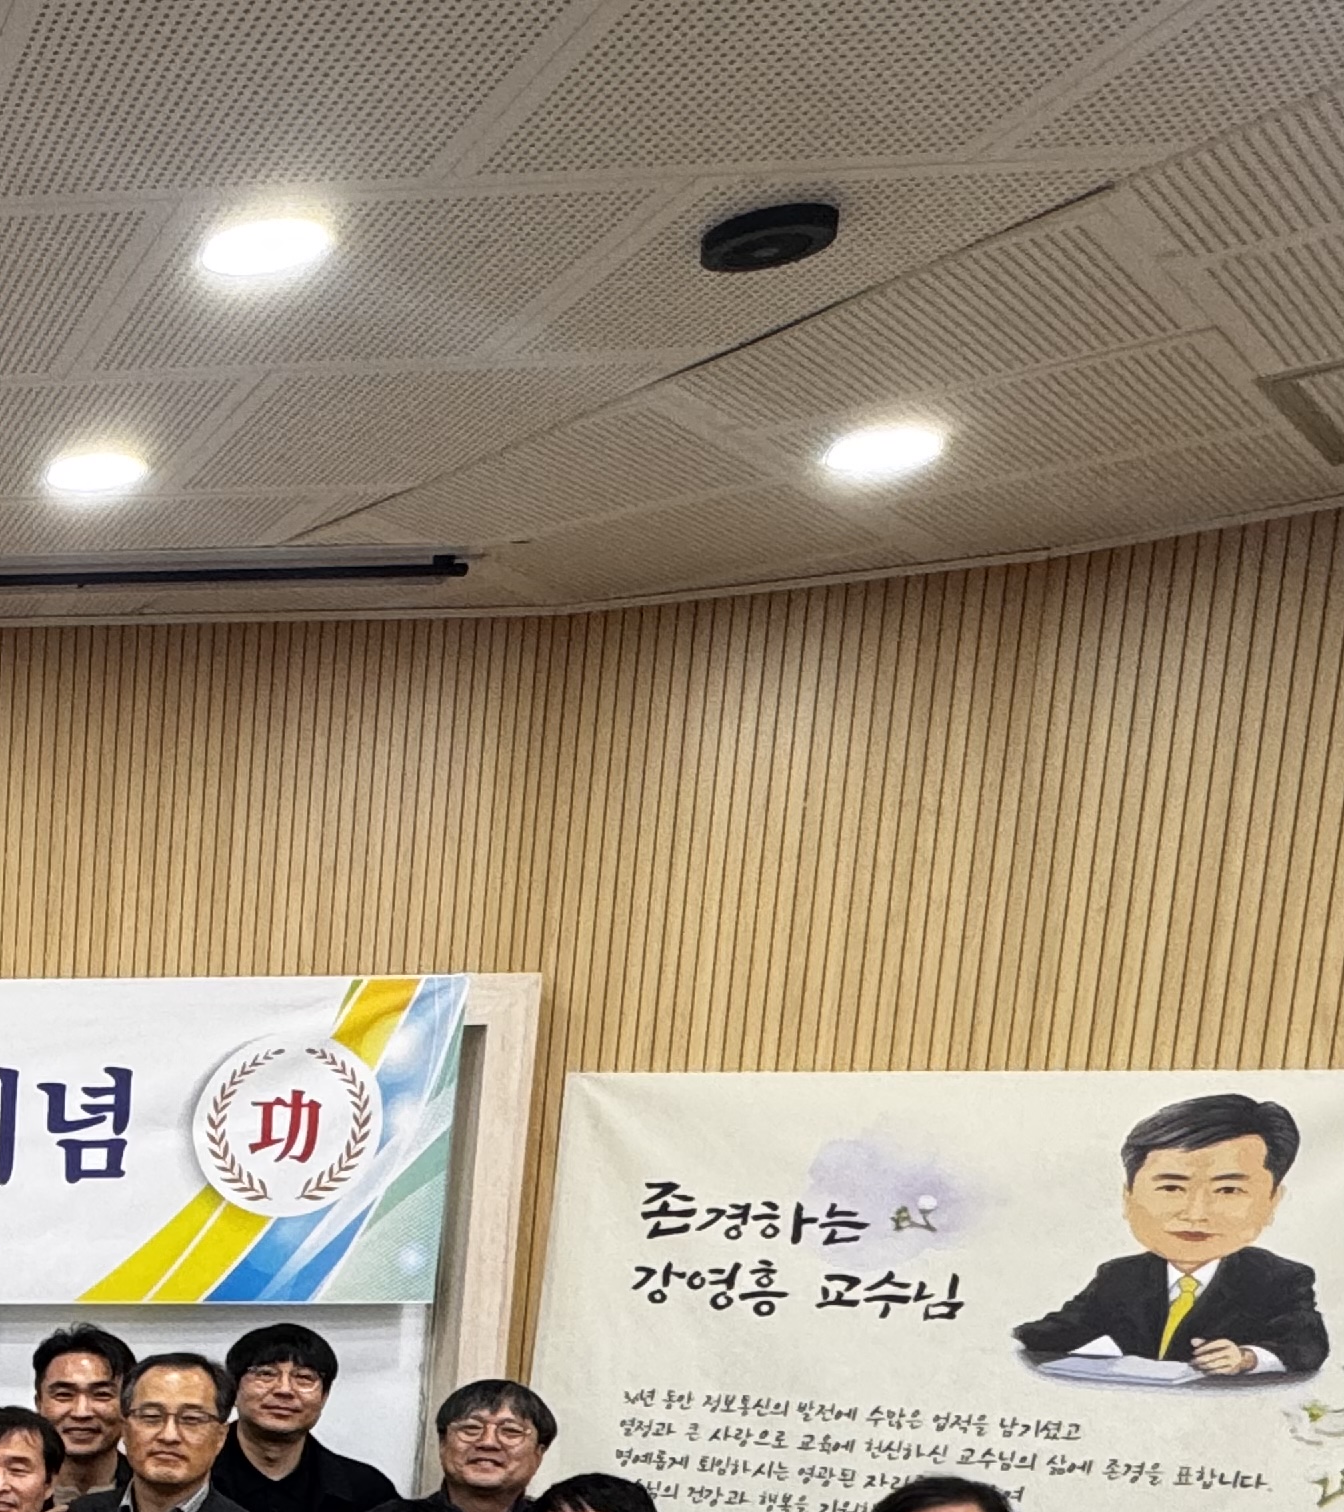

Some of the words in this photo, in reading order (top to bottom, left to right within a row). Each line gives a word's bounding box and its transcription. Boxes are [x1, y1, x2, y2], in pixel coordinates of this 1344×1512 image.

[249, 1089, 322, 1163] 功
[640, 1181, 871, 1246] 존경하는
[631, 1259, 789, 1317] 강영흥
[815, 1271, 965, 1321] 교수님
[662, 1390, 694, 1410] 동안
[702, 1394, 789, 1417] 정보통신의
[796, 1400, 858, 1422] 발전에
[866, 1406, 922, 1430] 수많은
[933, 1412, 988, 1437] 업적을
[999, 1417, 1081, 1441] 남기셨고
[616, 1448, 689, 1471] 명예롭게
[697, 1456, 789, 1481] 퇴임하시는
[798, 1465, 856, 1488] 영광된
[620, 1417, 676, 1438] 열정과
[685, 1423, 699, 1441] 큰
[708, 1425, 789, 1449] 사랑으로
[797, 1434, 856, 1455] 교육에
[865, 1438, 948, 1464] 헌신하신
[956, 1448, 1038, 1471] 교수님의
[1046, 1455, 1093, 1475] 삶에
[1103, 1459, 1163, 1486] 존경을
[1173, 1466, 1272, 1491] 표합니다.
[687, 1486, 751, 1507] 건강과
